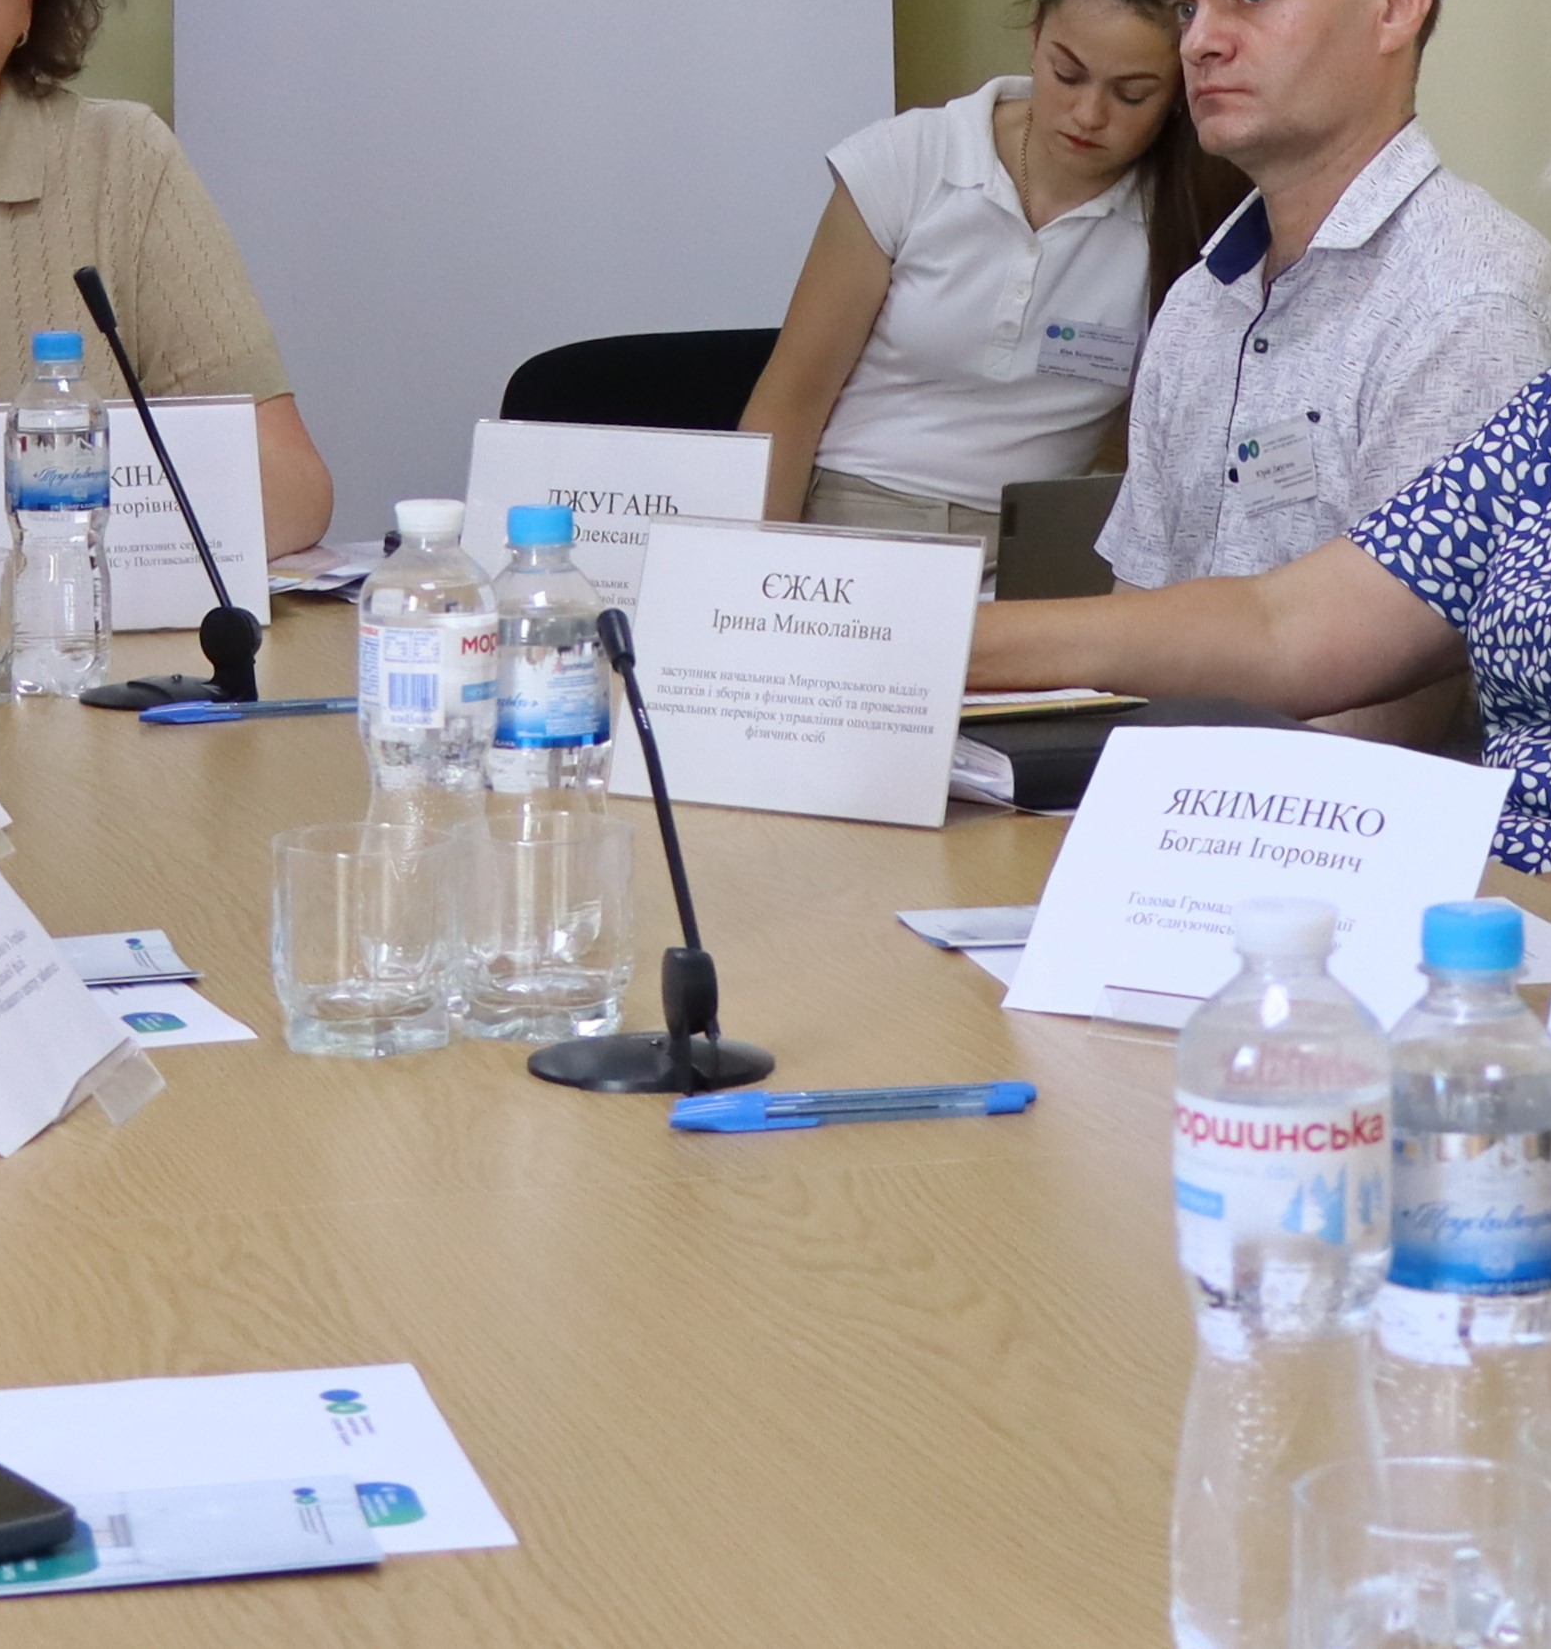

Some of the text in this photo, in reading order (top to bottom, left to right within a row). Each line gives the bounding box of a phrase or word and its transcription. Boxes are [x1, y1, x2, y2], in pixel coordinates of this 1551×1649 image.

[761, 572, 854, 604] ЄЖАК
[711, 608, 892, 642] Ірина Миколаївна
[657, 682, 705, 697] податків
[715, 685, 751, 702] зборів
[762, 689, 815, 707] фізичних
[818, 695, 843, 708] осіб
[846, 700, 858, 710] та
[860, 700, 929, 716] проведення
[660, 666, 930, 701] заступник начальника Миргородського відділу
[645, 700, 934, 735] камеральних перевірок управління оподаткування
[745, 725, 827, 744] фізичних осіб
[1163, 788, 1387, 838] ЯКИМЕНКО
[1158, 828, 1364, 873] Богдан Ігорович
[1128, 891, 1233, 915] Голова Громад
[1174, 1105, 1385, 1153] оршинська
